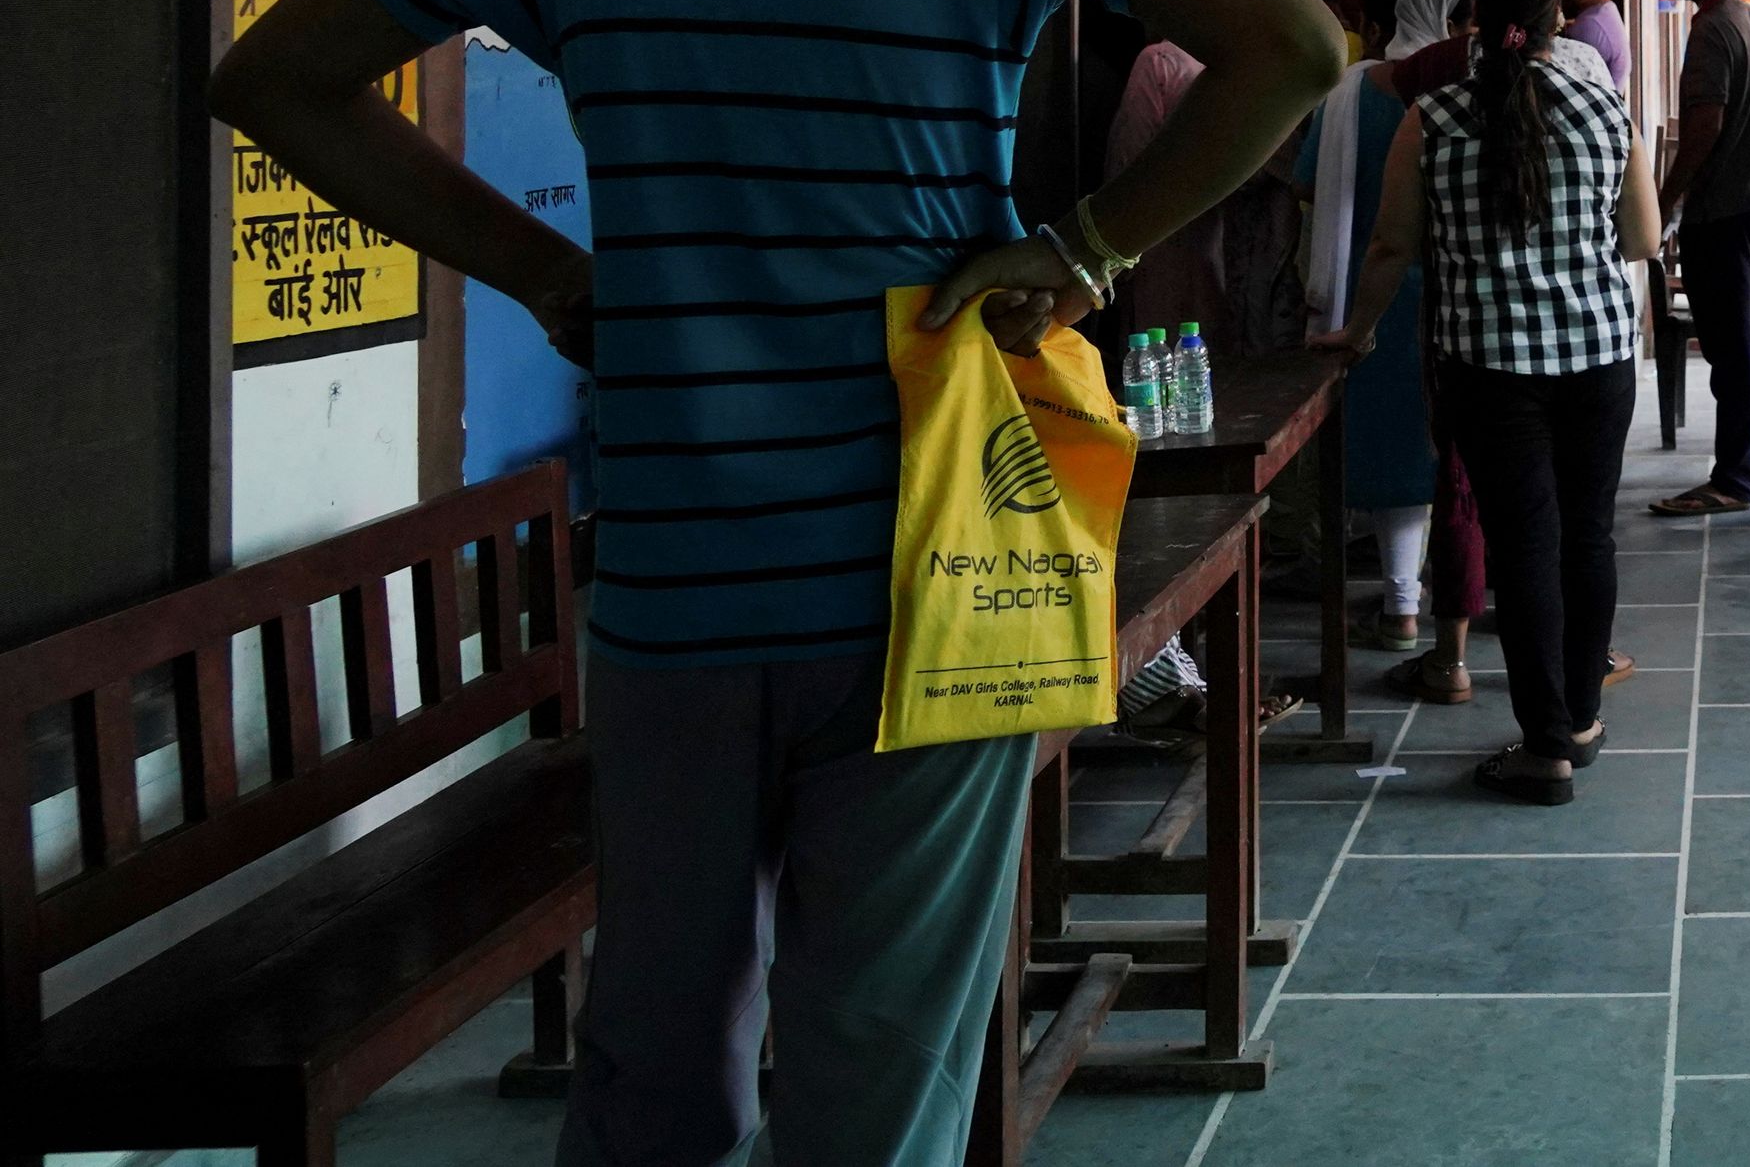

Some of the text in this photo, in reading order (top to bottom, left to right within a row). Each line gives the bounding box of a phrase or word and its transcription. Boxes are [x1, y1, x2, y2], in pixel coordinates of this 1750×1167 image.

[525, 184, 576, 213] अरब सागर
[242, 212, 300, 271] स्कूल
[320, 253, 366, 315] ओर
[929, 550, 998, 578] New
[972, 581, 1073, 616] Sports
[924, 686, 948, 699] Near
[950, 683, 972, 696] DAV
[975, 681, 999, 694] Girls
[1000, 679, 1037, 693] College,
[1039, 674, 1072, 690] Railway
[993, 693, 1034, 708] KARNAL
